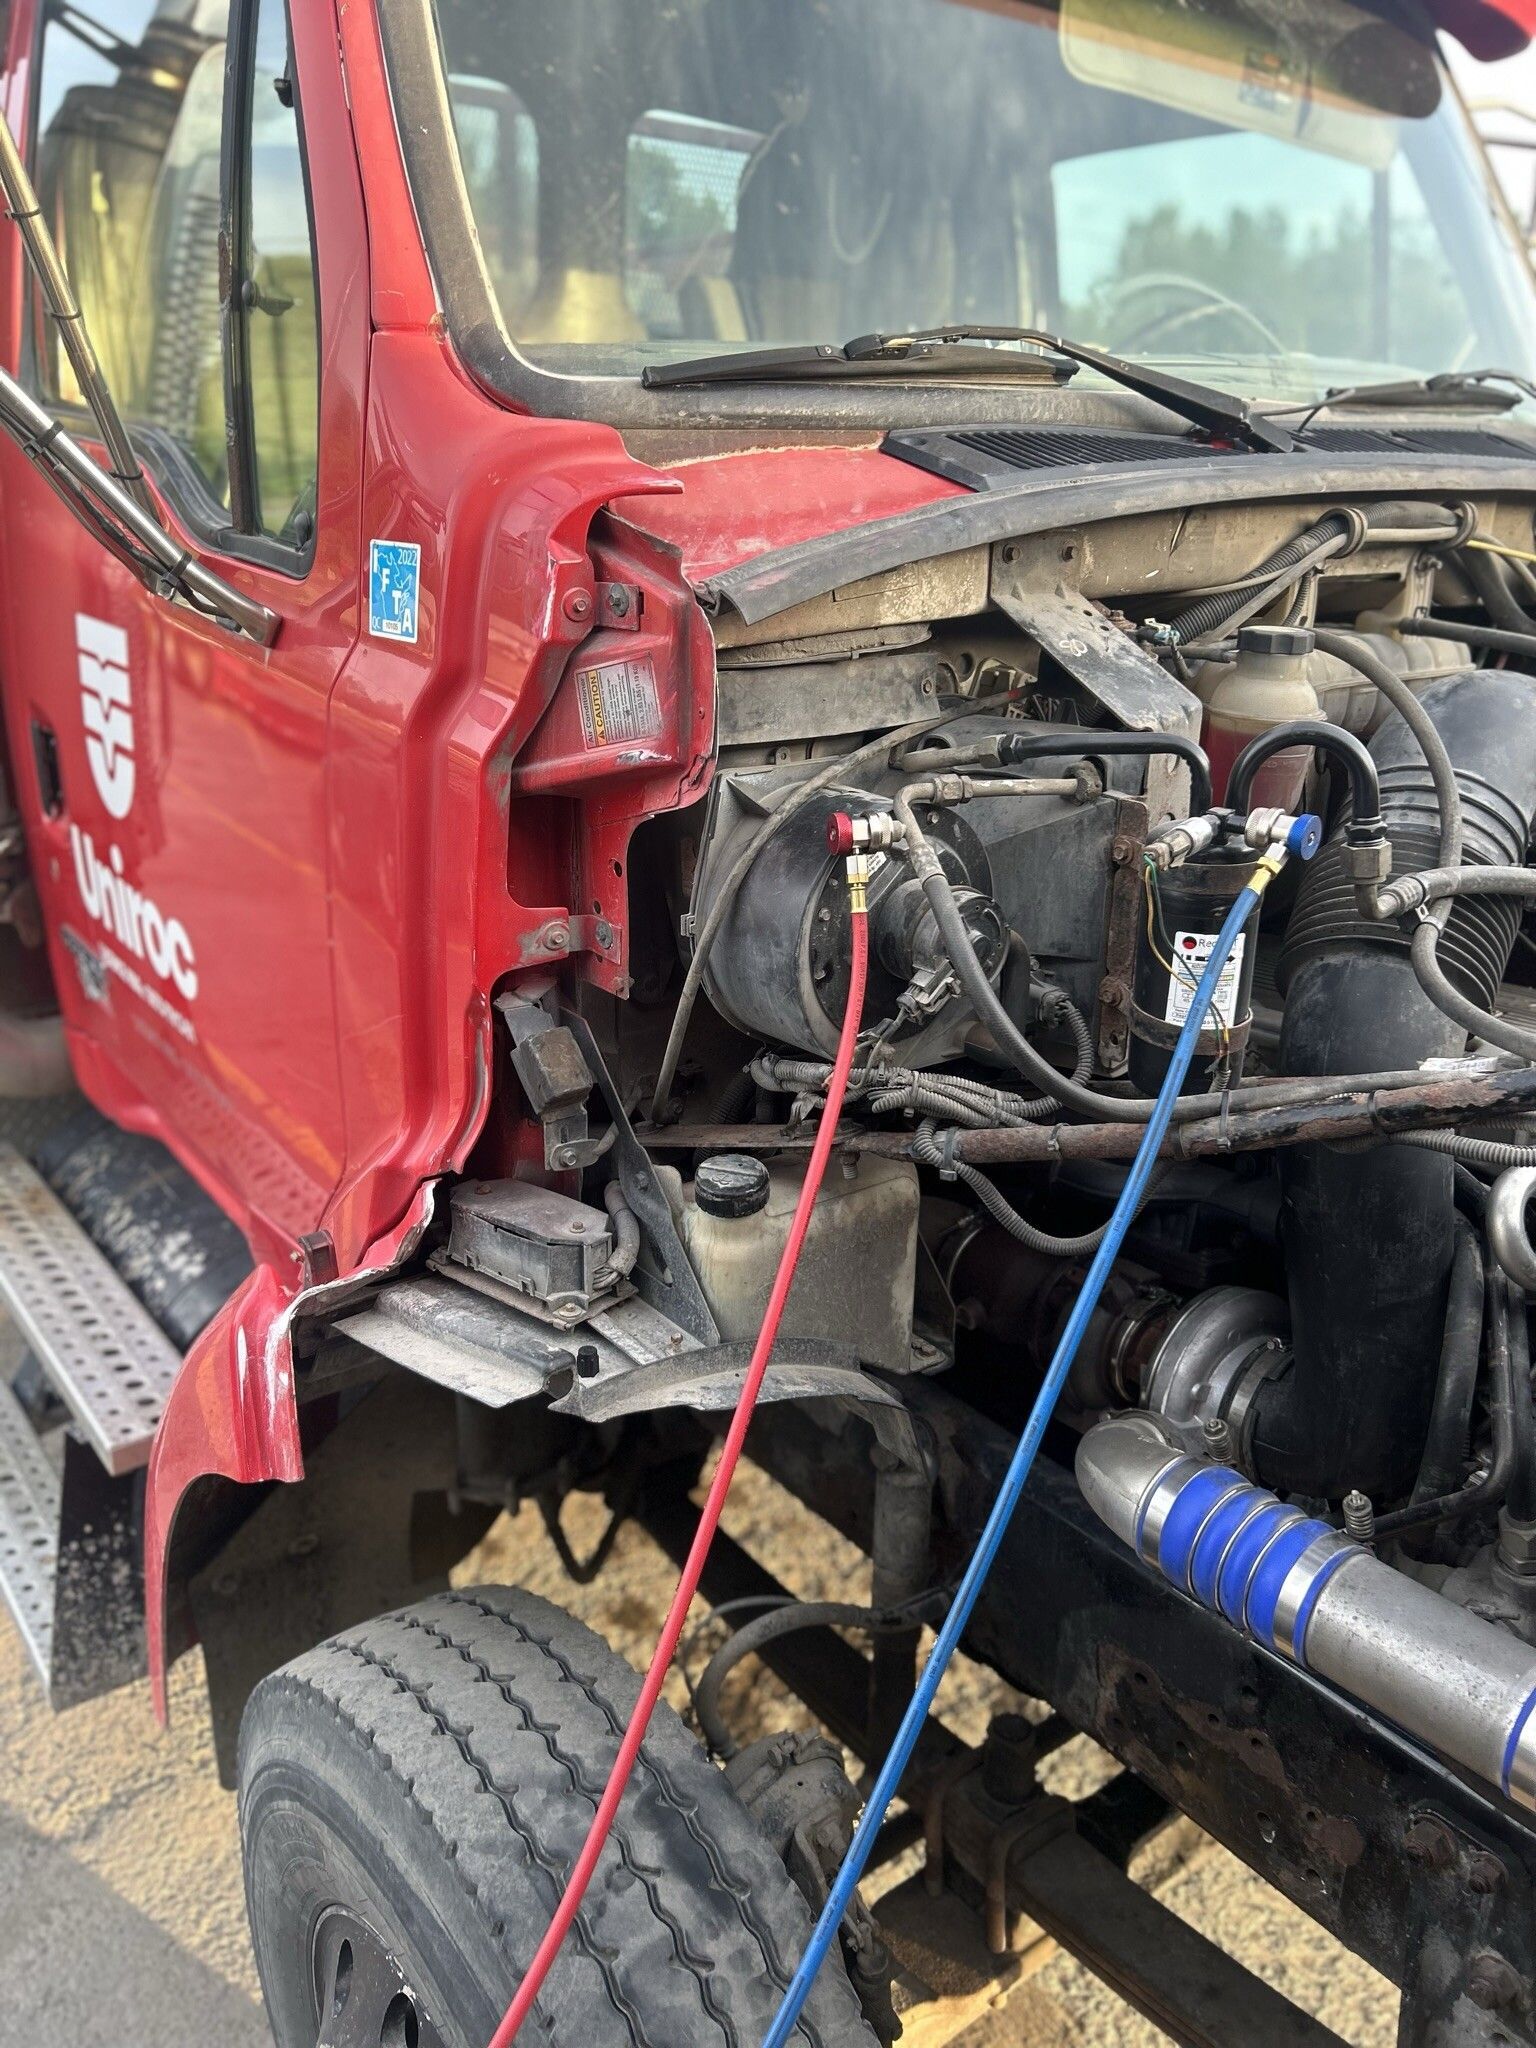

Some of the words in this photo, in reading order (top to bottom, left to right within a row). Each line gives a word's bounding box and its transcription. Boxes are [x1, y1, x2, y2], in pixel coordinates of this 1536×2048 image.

[398, 549, 417, 566] 2022
[581, 678, 591, 729] Conditioner
[590, 676, 603, 727] CAUTION
[70, 823, 198, 1000] Uniroc
